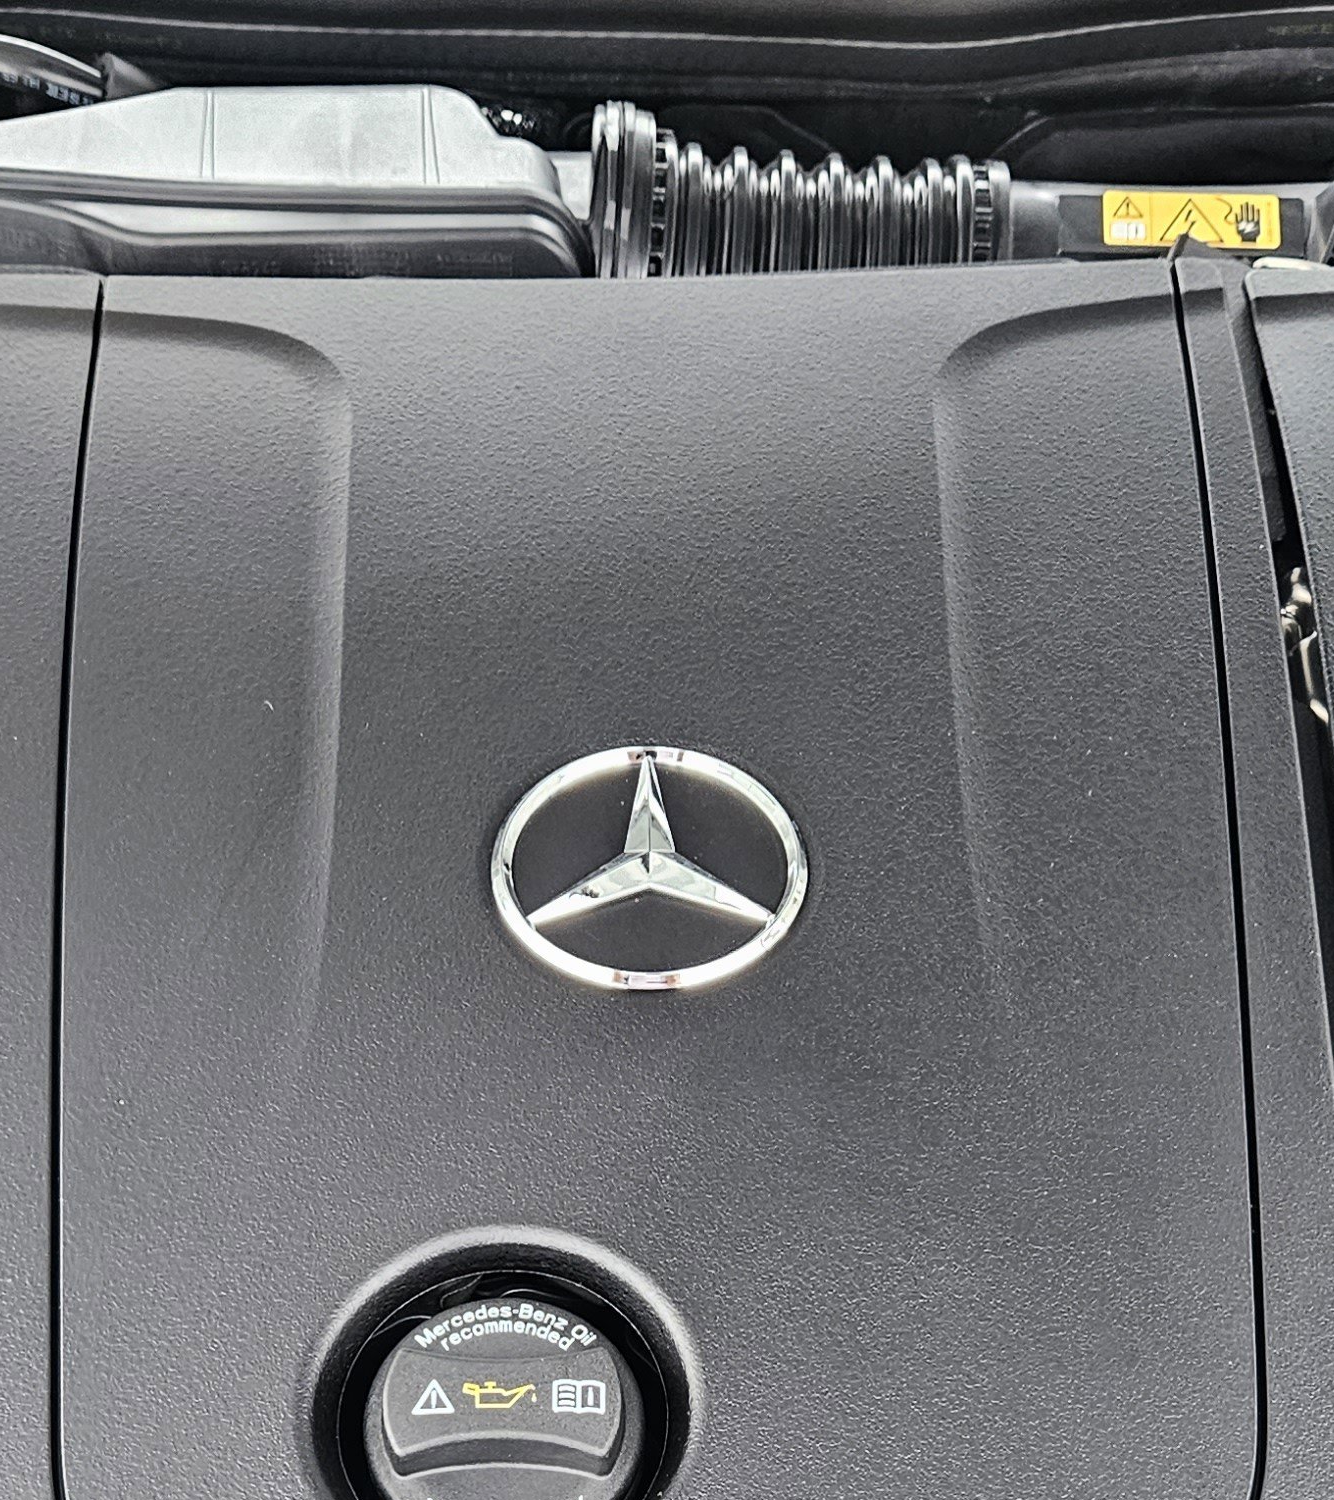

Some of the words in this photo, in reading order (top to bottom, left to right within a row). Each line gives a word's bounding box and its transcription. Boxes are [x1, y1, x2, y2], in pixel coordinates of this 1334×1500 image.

[414, 1303, 569, 1348] Mercedes-Benz
[571, 1323, 597, 1347] Oil
[440, 1318, 574, 1351] recommended
